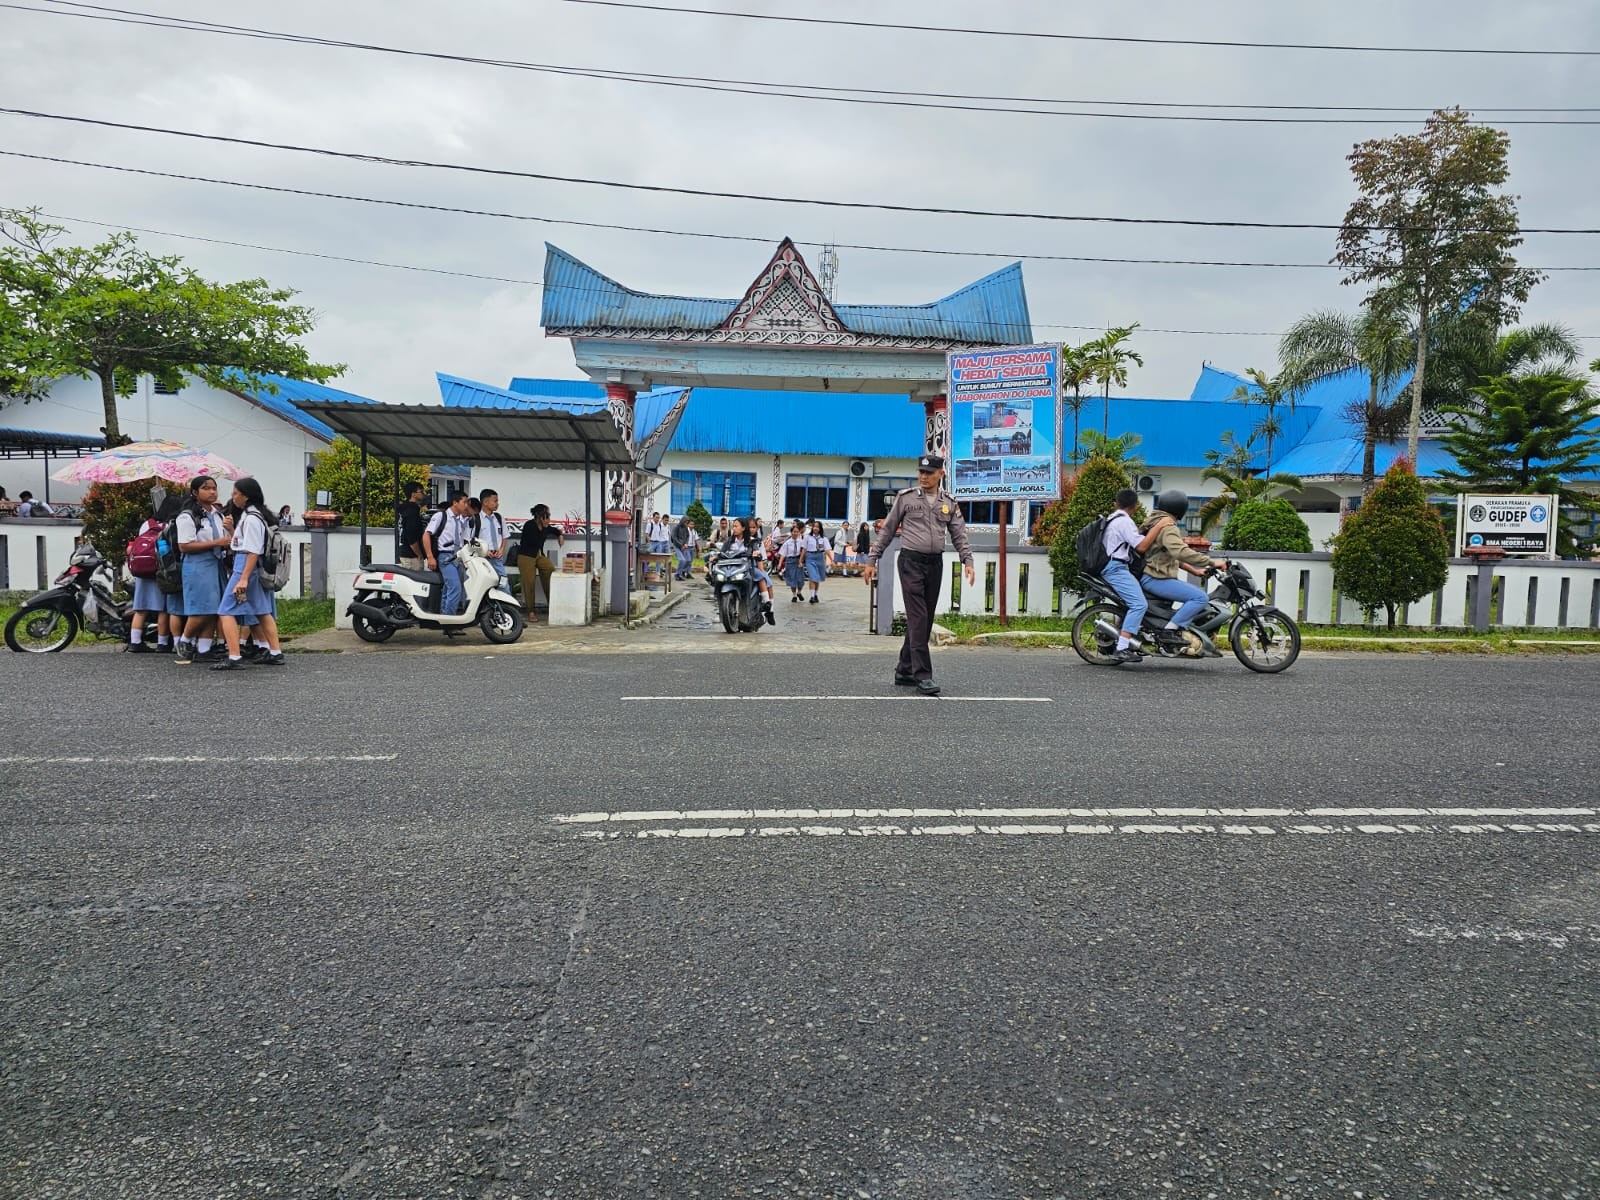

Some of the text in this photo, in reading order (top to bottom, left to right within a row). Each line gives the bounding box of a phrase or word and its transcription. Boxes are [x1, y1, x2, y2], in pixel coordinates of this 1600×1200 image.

[955, 352, 1051, 368] MAJU BERSAMA
[960, 366, 1046, 380] HEBAT SEMUA
[956, 391, 1010, 401] HABONARON
[1489, 511, 1527, 522] GUDEP
